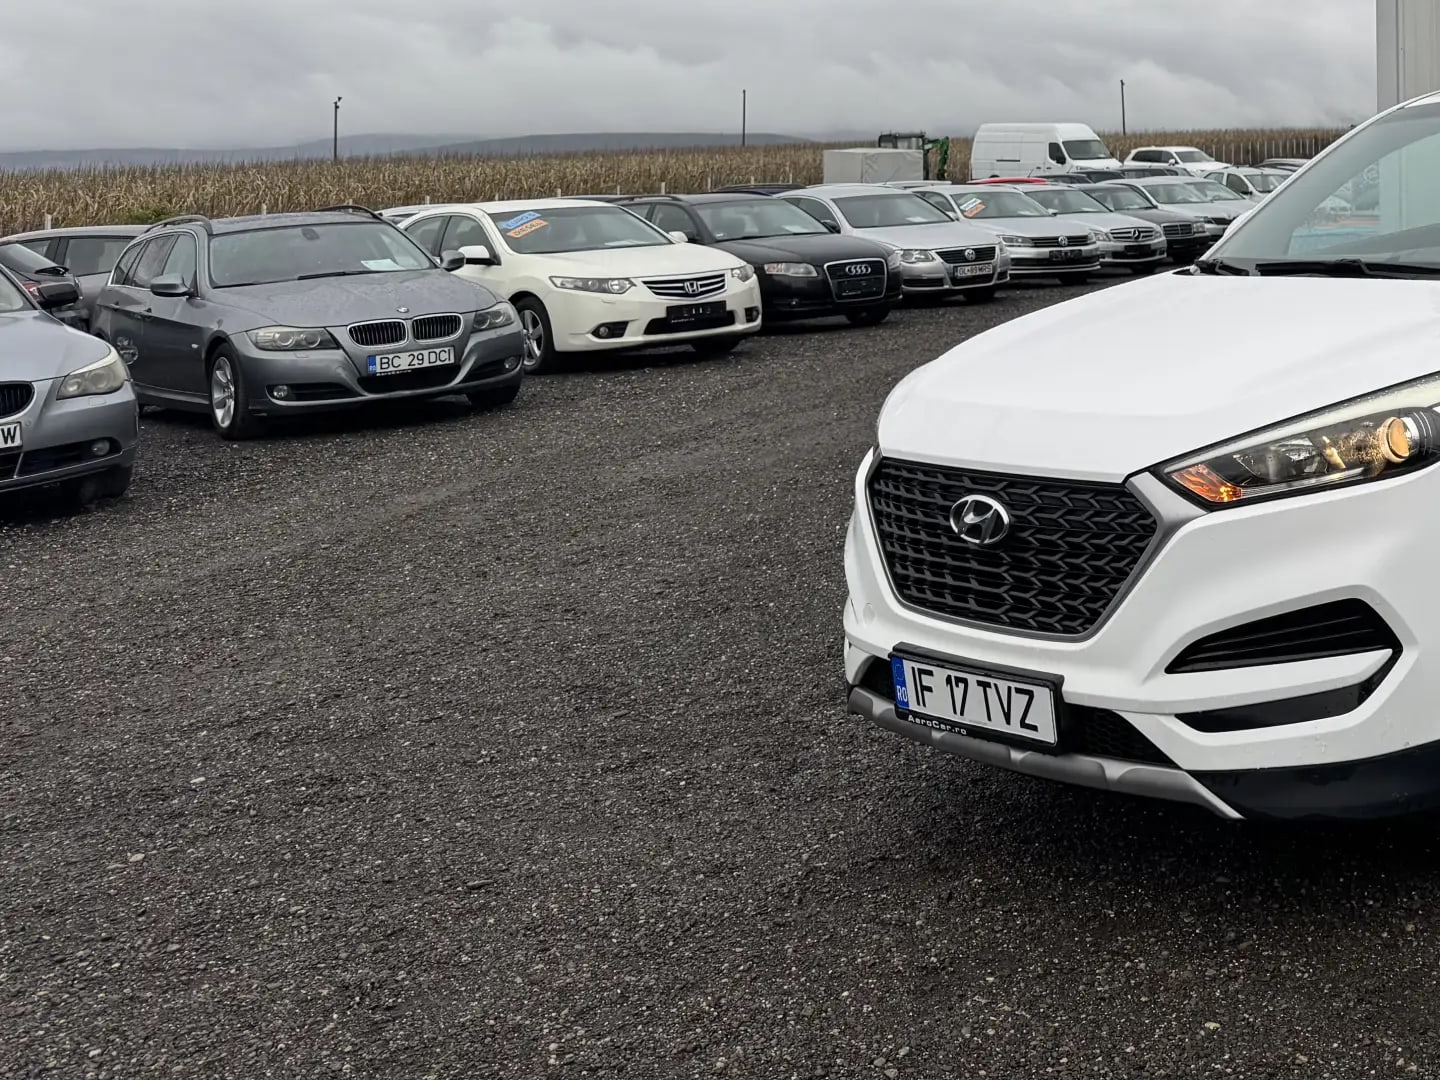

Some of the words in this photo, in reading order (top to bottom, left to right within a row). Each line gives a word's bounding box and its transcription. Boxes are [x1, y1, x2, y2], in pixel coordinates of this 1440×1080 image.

[380, 355, 401, 370] BC
[407, 352, 425, 367] 29
[428, 349, 451, 365] DCI
[896, 685, 908, 703] RO
[911, 666, 934, 708] IF
[945, 674, 969, 717] 17
[976, 679, 1039, 732] TVZ
[908, 714, 967, 735] AeroCar.ro
